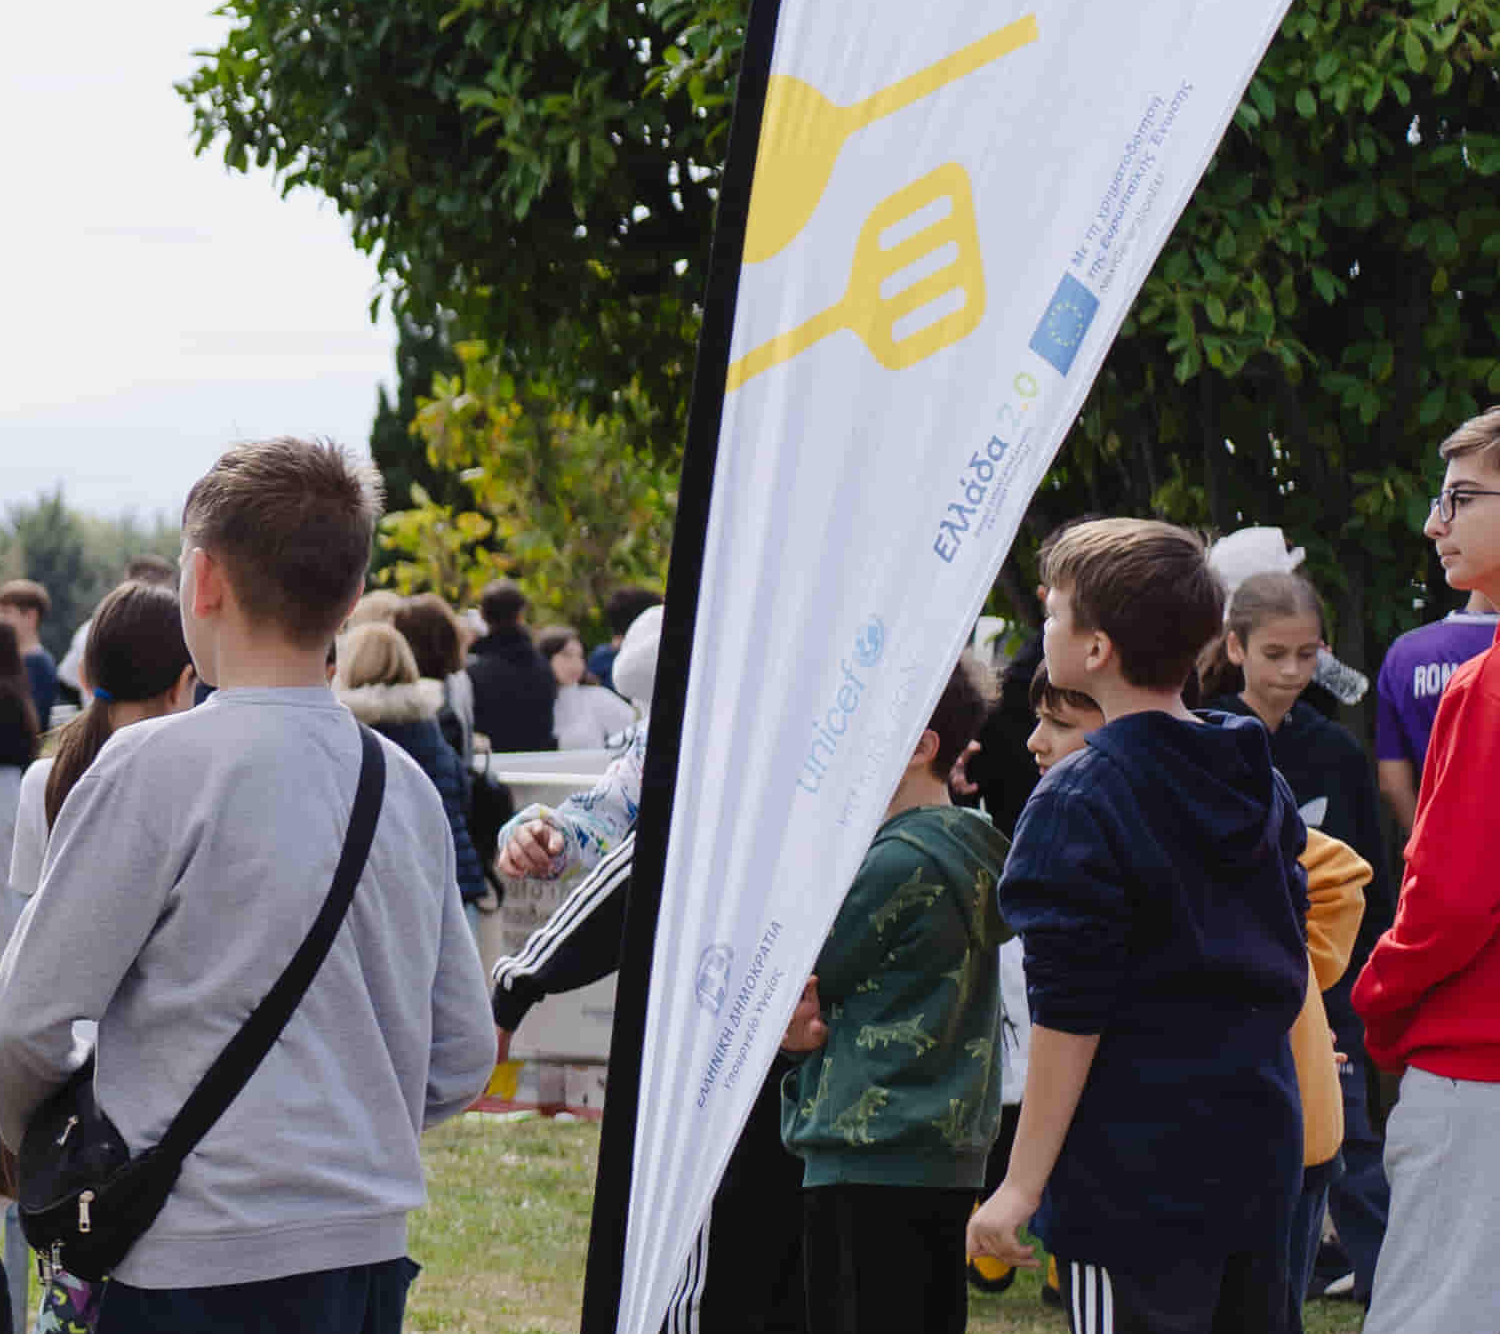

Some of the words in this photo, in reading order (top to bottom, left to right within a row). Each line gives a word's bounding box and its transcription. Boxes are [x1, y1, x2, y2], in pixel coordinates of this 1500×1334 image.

[932, 433, 1010, 564] Ελλάδα
[795, 657, 867, 796] unicef
[731, 919, 784, 1029] ΔΗΜΟΚΡΑΤΙΑ
